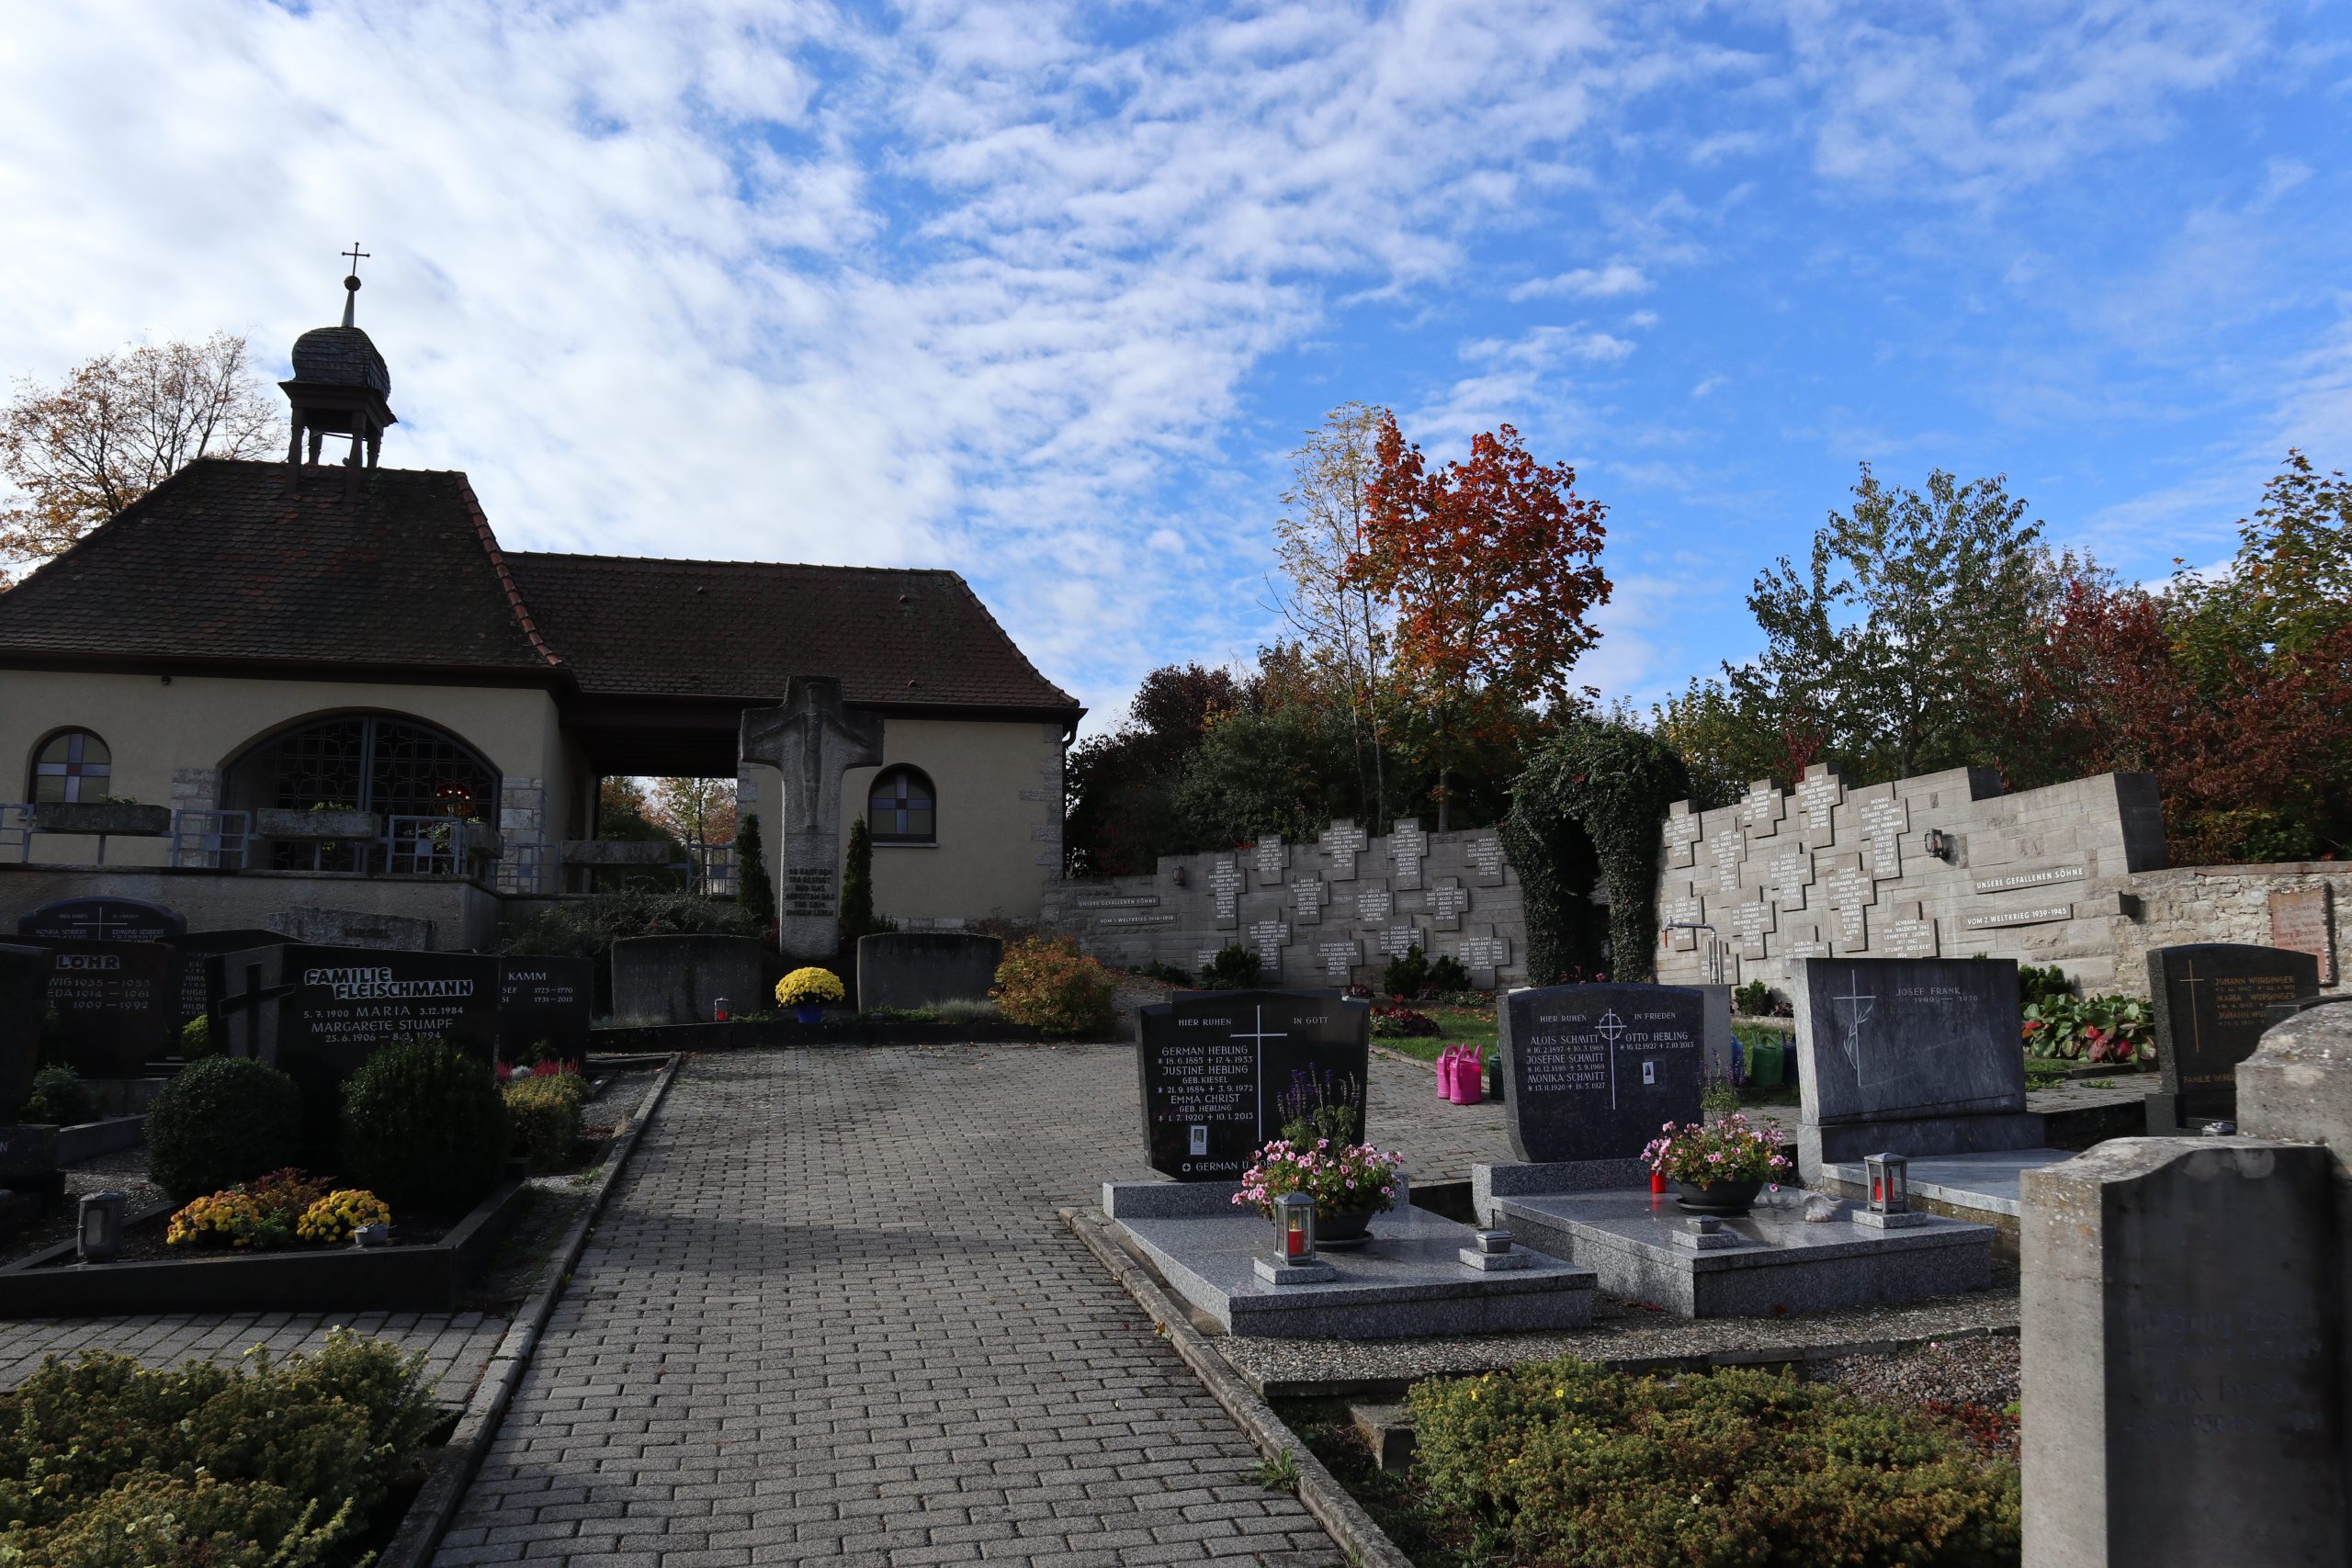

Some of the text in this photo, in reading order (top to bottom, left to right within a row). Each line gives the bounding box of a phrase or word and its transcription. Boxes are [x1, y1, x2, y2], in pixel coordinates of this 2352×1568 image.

[1871, 795, 1891, 805] MENNIG
[1881, 819, 1904, 829] HERMANN
[1874, 834, 1892, 842] CHRIST
[1874, 840, 1894, 849] VIKTOR
[1875, 853, 1894, 862] KOSLER
[1838, 866, 1857, 874] STUMPF
[1976, 866, 2085, 890] UNSERE GEFALLENEN SÖHNE
[1137, 897, 1158, 905] SÖHNE
[1840, 903, 1860, 911] BENDER
[1967, 917, 1984, 926] VOM
[1990, 911, 2030, 923] WELTKRIEG
[2031, 907, 2067, 919] 1939-1945
[1894, 919, 1917, 927] SCHRANK
[1912, 930, 1930, 938] LUDWIG
[1906, 943, 1931, 952] ADELBERT
[304, 967, 394, 986] FAMILIE
[508, 971, 547, 981] KAMM
[2214, 976, 2247, 986] JOHANN
[334, 979, 474, 1000] FLEISCHMANN
[1895, 987, 1962, 997] JOSEF FRANK
[356, 1005, 412, 1018] MARIA
[1645, 1011, 1676, 1020] FRIEDEN
[1203, 1018, 1232, 1026] RUHEN
[1306, 1016, 1329, 1024] GOTT
[311, 1018, 454, 1033] MARGARETE STUMPF
[1531, 1033, 1600, 1046] ALOIS SCHMITT
[1625, 1031, 1689, 1042] OTTO HEBLING
[1162, 1045, 1248, 1056] GERMAN HEBLING
[1526, 1053, 1604, 1065] JOSEFINE SCHMITT
[1162, 1065, 1248, 1076] JUSTINE HEBLING
[1201, 1076, 1228, 1084] KIESEL
[1527, 1071, 1605, 1084] MONIKA SCHMITT
[1170, 1093, 1240, 1104] EMMA CHRIST
[1199, 1104, 1232, 1112] HEBLING
[1195, 1160, 1251, 1171] GERMAN U.
